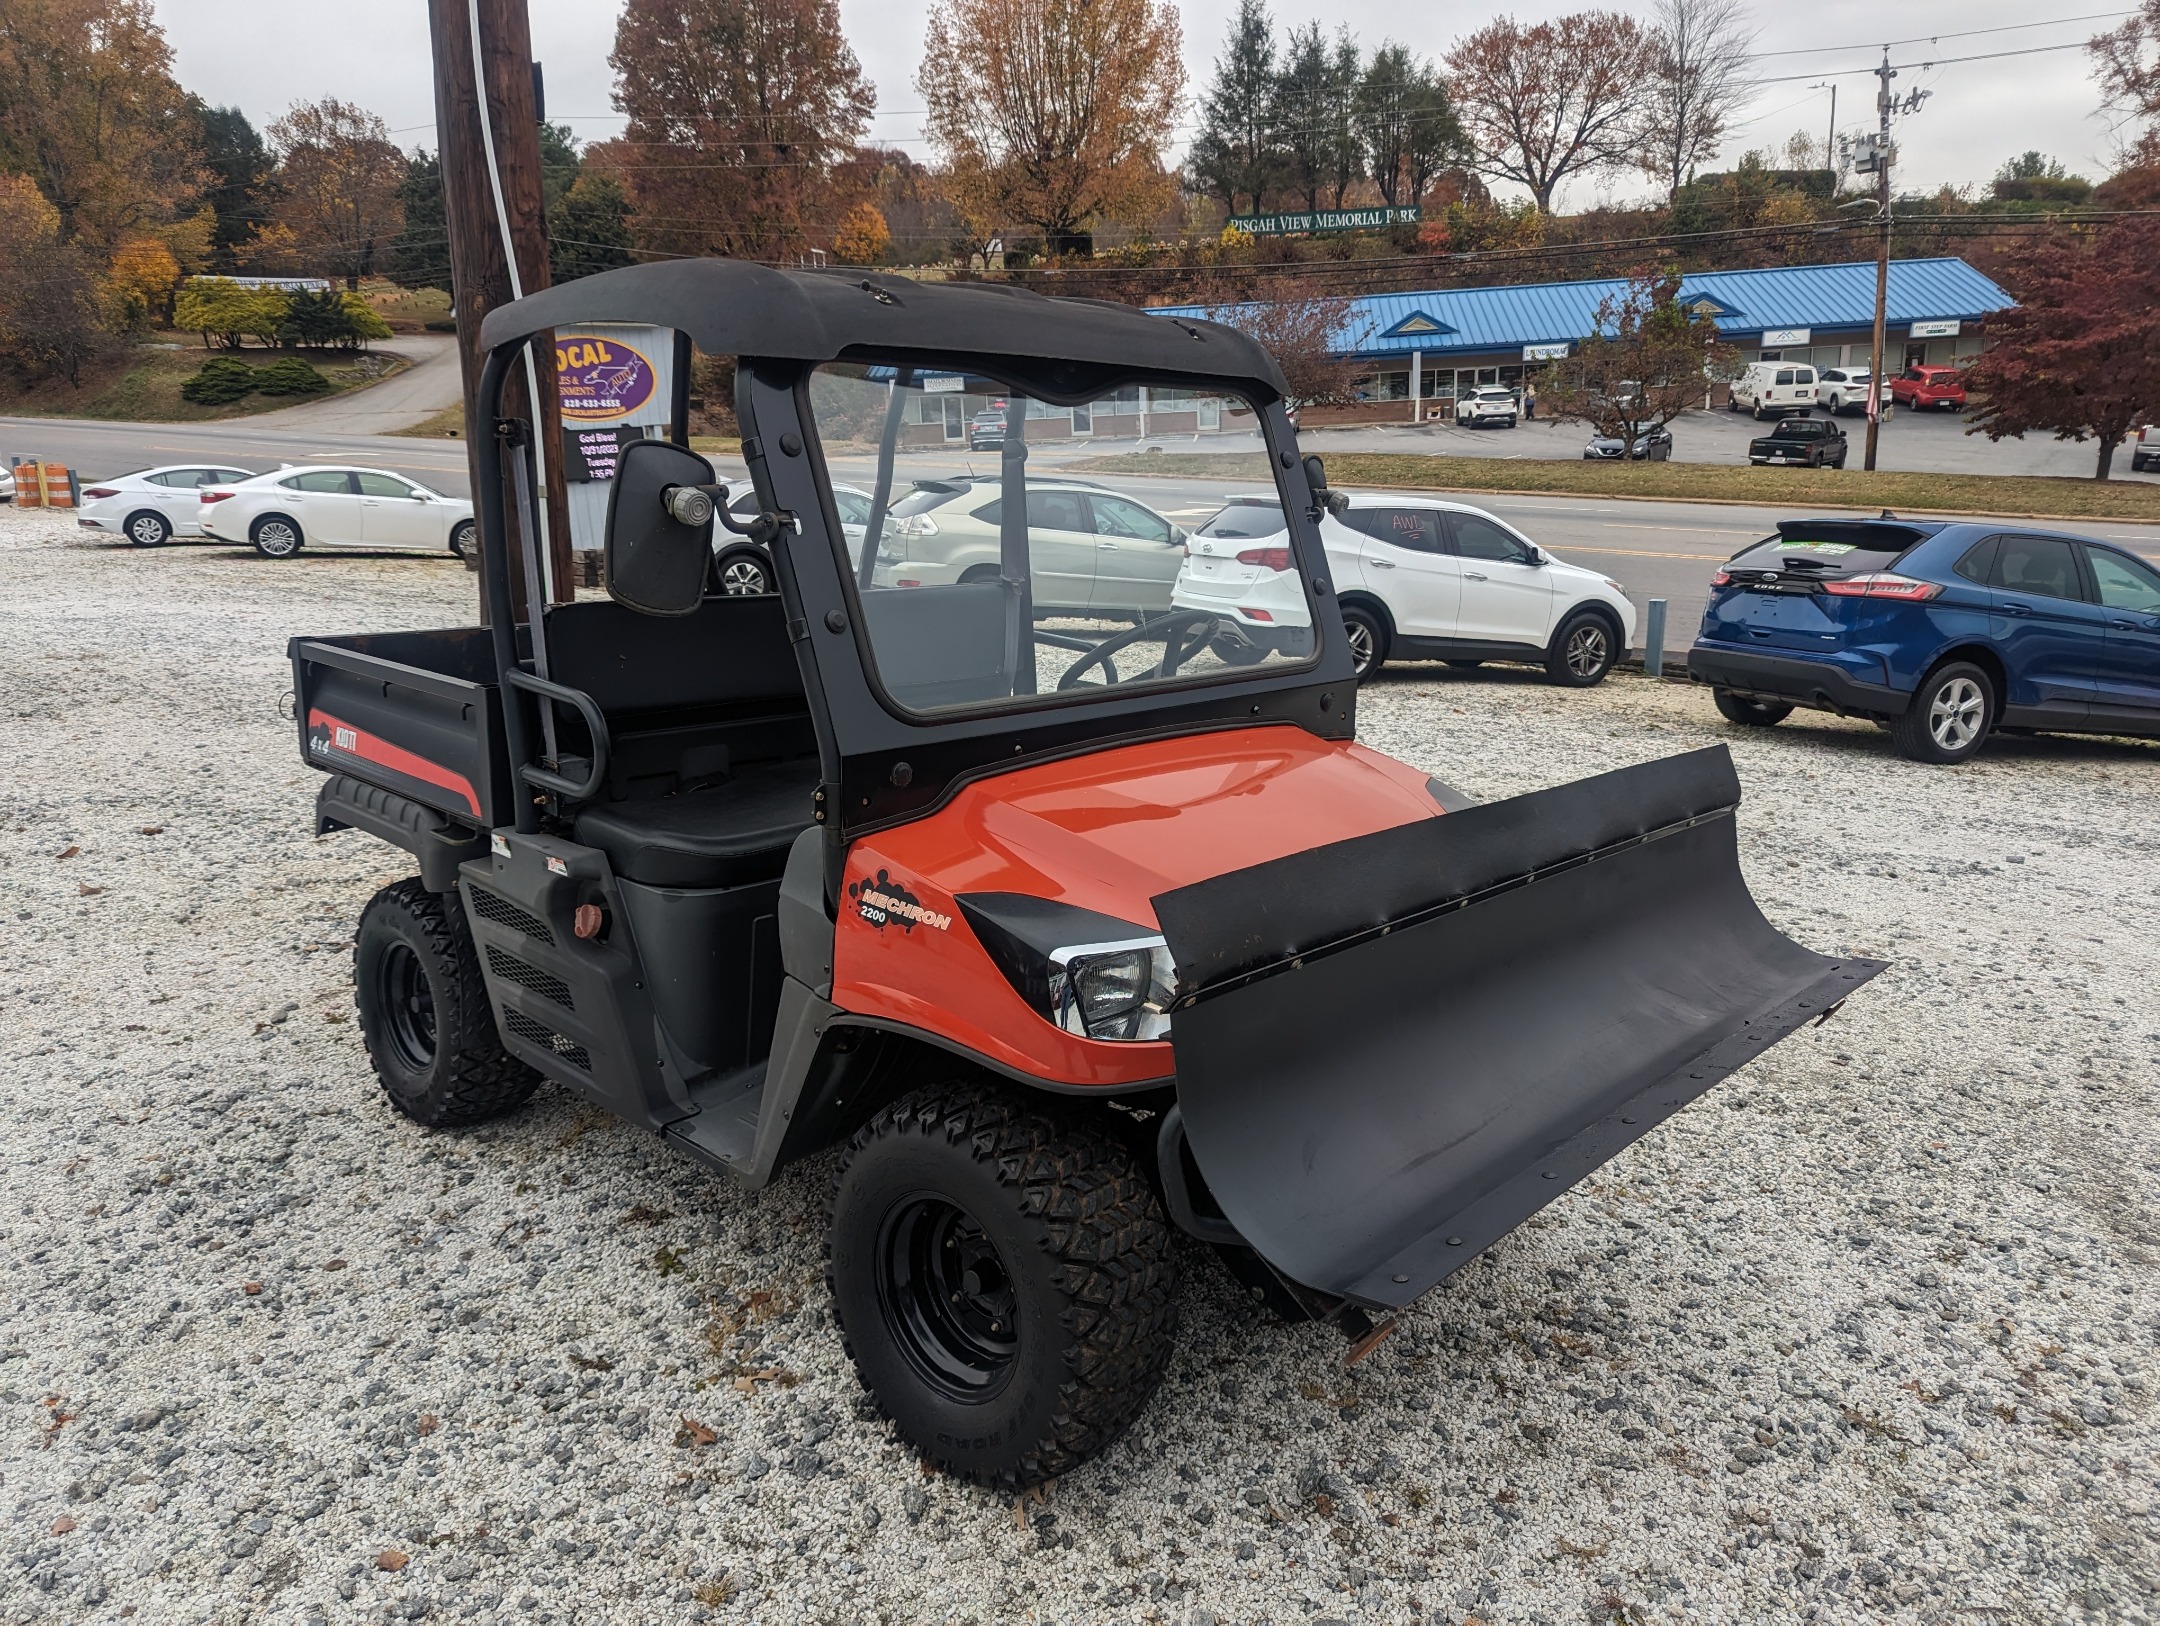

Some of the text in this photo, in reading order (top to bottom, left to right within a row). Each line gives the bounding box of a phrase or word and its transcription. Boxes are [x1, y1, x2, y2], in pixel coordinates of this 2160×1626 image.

[1230, 218, 1275, 232] PISGAH
[1279, 215, 1312, 230] VIEW
[1315, 211, 1382, 229] MEMORIAL
[556, 341, 612, 372] OCAL
[611, 369, 631, 386] AUTO
[579, 433, 596, 443] God
[585, 457, 616, 467] Tuesday
[1393, 515, 1425, 530] AWD
[335, 726, 357, 751] KIOTI
[860, 905, 886, 923] 2200
[861, 888, 952, 931] MECHRON
